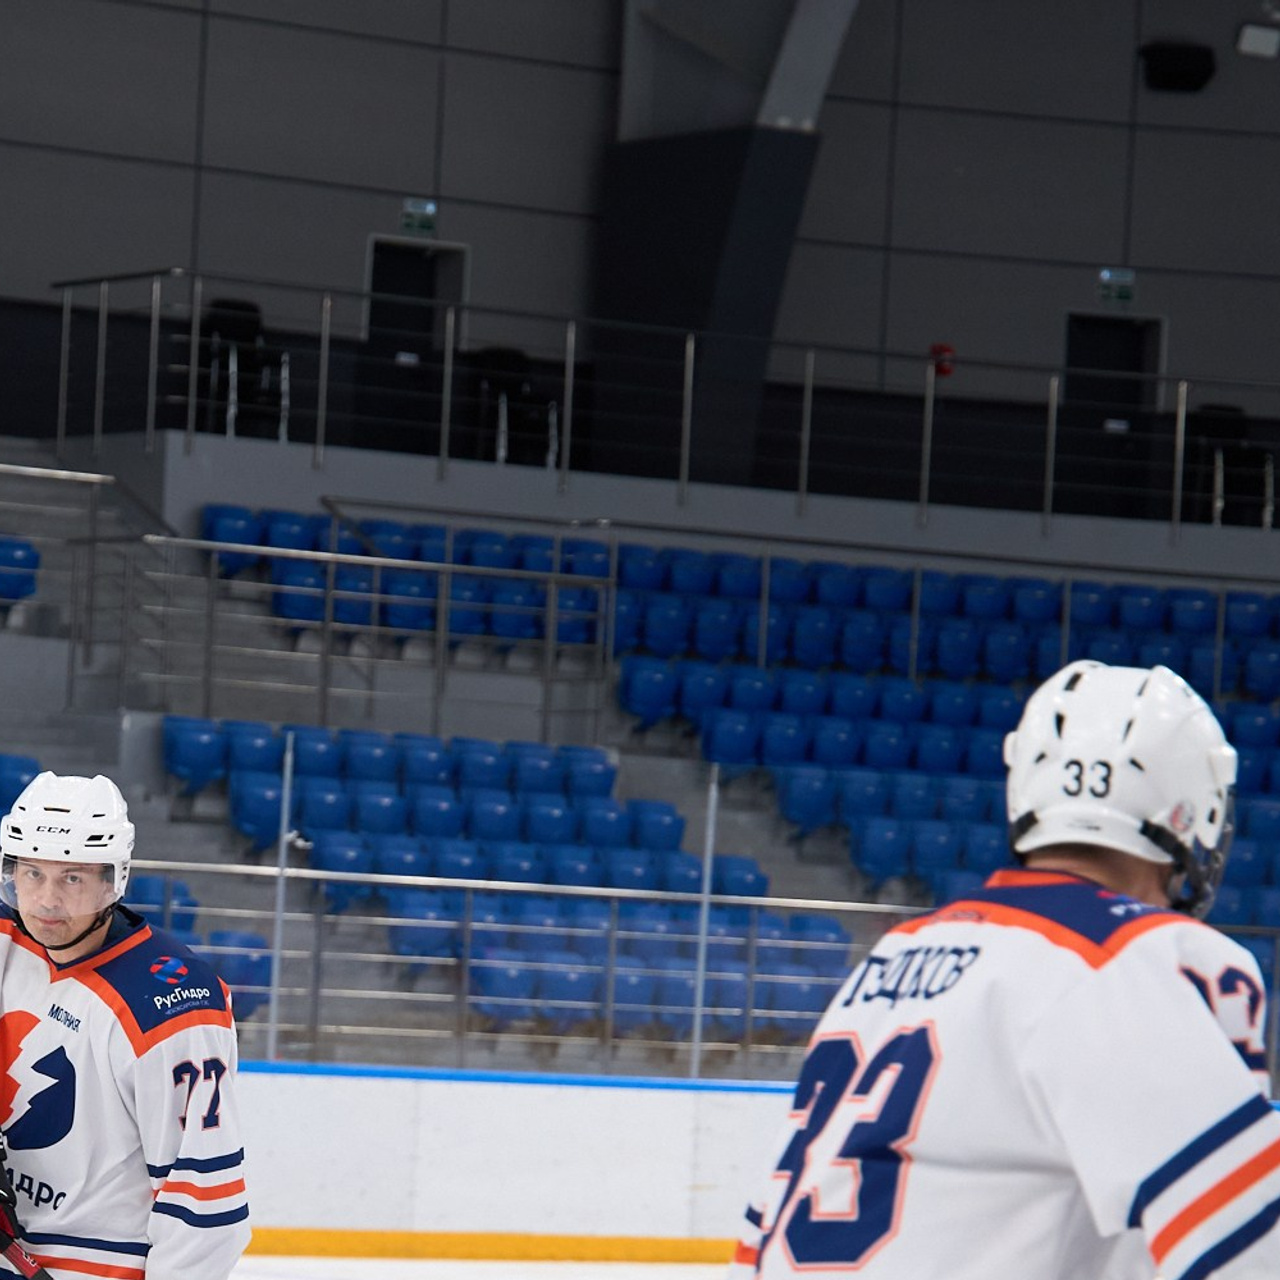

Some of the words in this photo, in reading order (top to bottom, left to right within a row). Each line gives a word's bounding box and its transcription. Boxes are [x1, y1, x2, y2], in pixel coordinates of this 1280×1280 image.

[1062, 759, 1112, 798] 33
[36, 825, 71, 835] CCM
[153, 987, 210, 1010] РусГидро
[172, 1058, 227, 1131] 77
